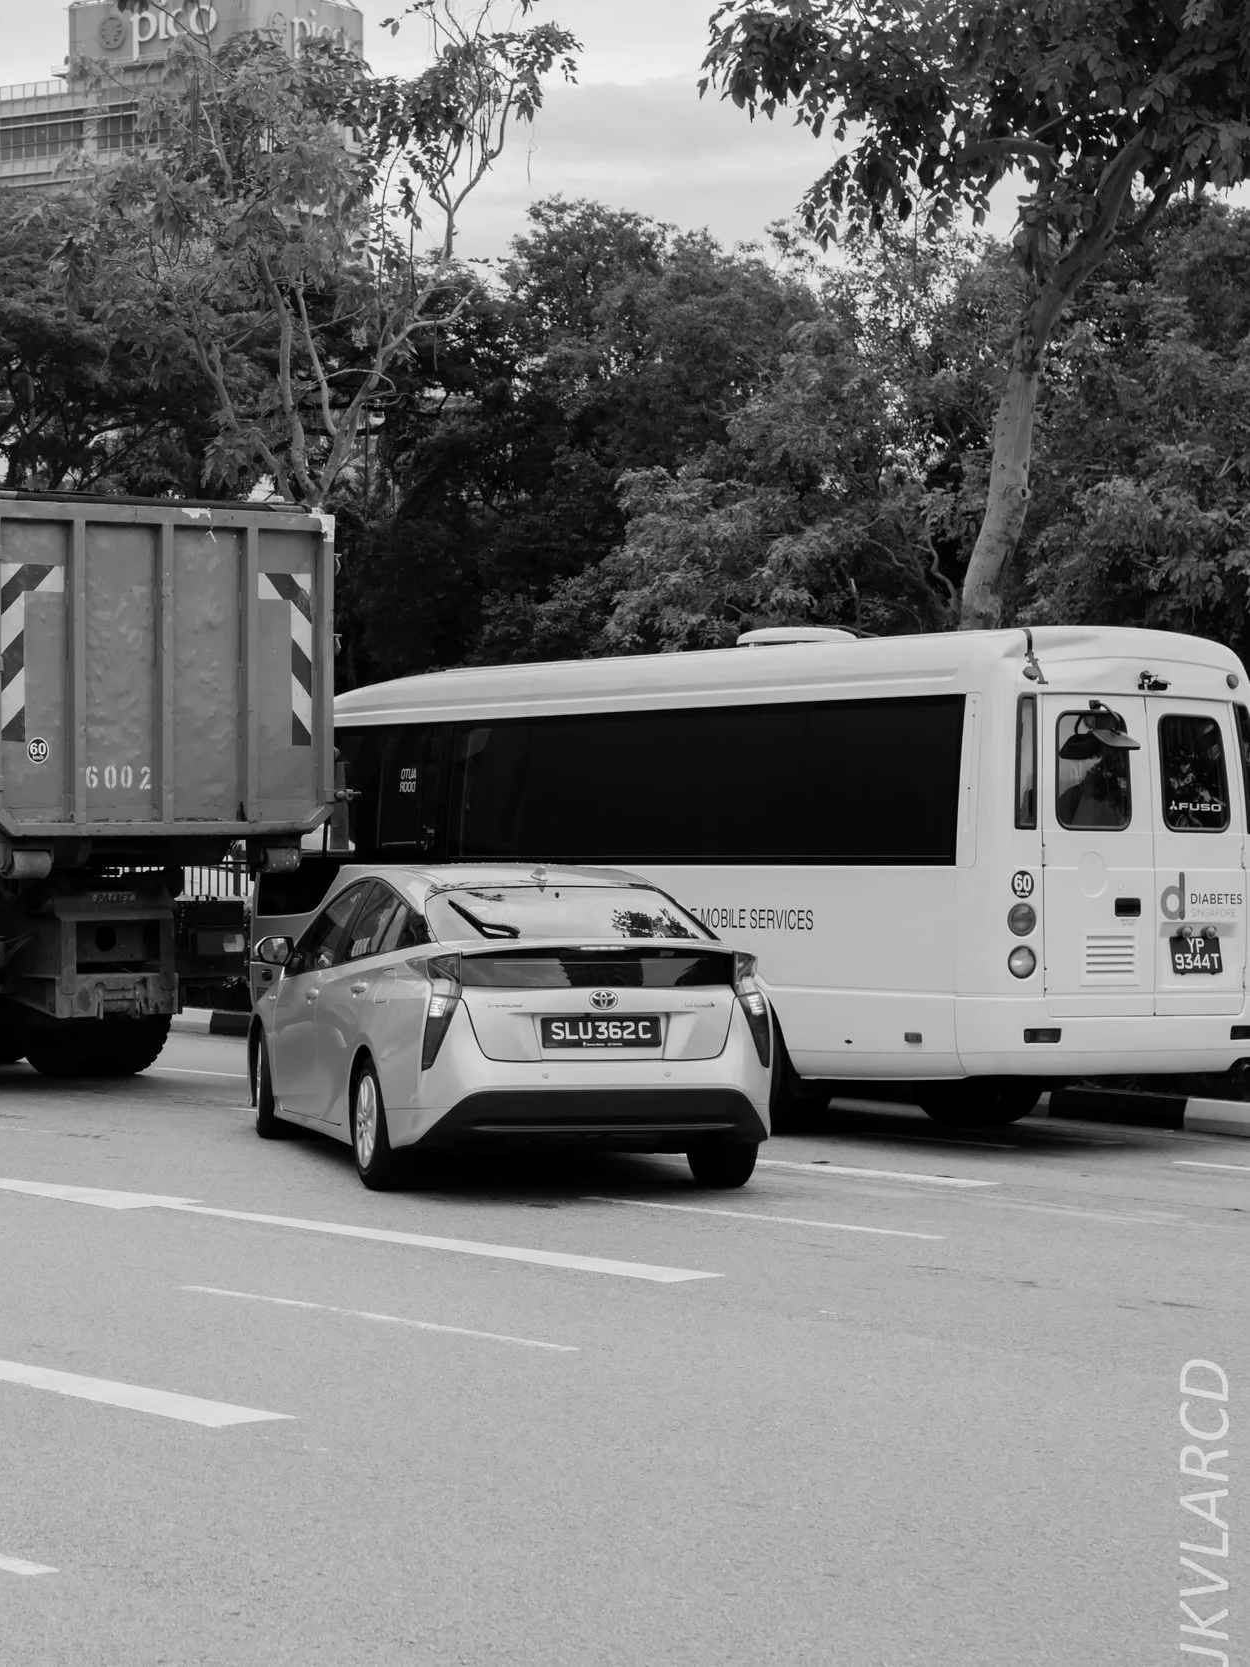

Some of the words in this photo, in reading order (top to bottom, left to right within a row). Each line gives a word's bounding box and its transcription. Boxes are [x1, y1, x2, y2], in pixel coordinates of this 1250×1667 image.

[130, 0, 217, 61] pico
[30, 742, 47, 755] 60
[85, 765, 151, 789] 6002
[1179, 803, 1222, 812] FUSO
[1013, 874, 1032, 891] 60
[1190, 893, 1243, 905] DIABETES
[700, 908, 746, 928] MOBILE
[749, 909, 814, 930] SERVICES
[1190, 908, 1237, 918] SINGAPORE
[1187, 938, 1205, 953] YP
[1174, 953, 1220, 970] 9344T
[551, 1021, 652, 1040] SLU362C
